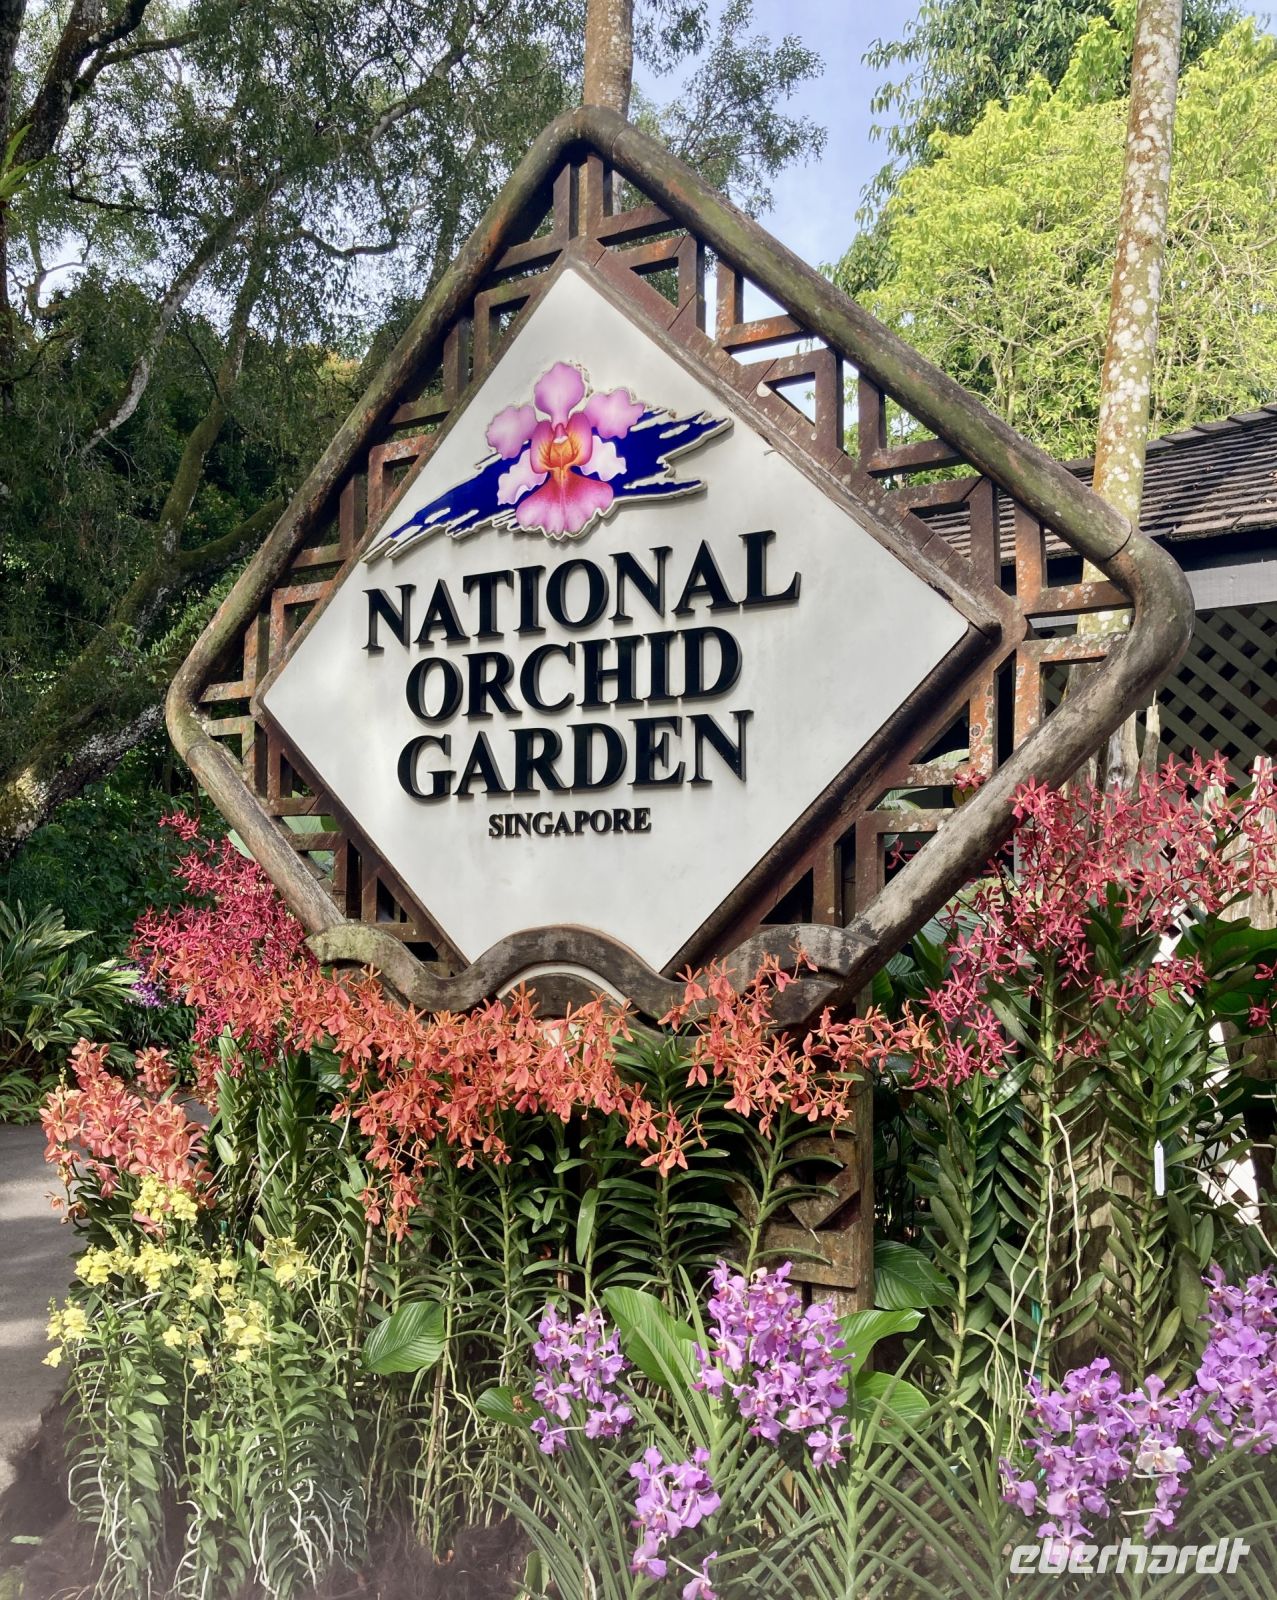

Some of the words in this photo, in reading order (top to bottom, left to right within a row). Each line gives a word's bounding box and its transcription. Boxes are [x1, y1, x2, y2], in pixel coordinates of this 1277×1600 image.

[362, 529, 802, 653] NATIONAL
[405, 626, 742, 723] ORCHID
[397, 709, 754, 801] GARDEN
[488, 807, 652, 838] SINGAPORE
